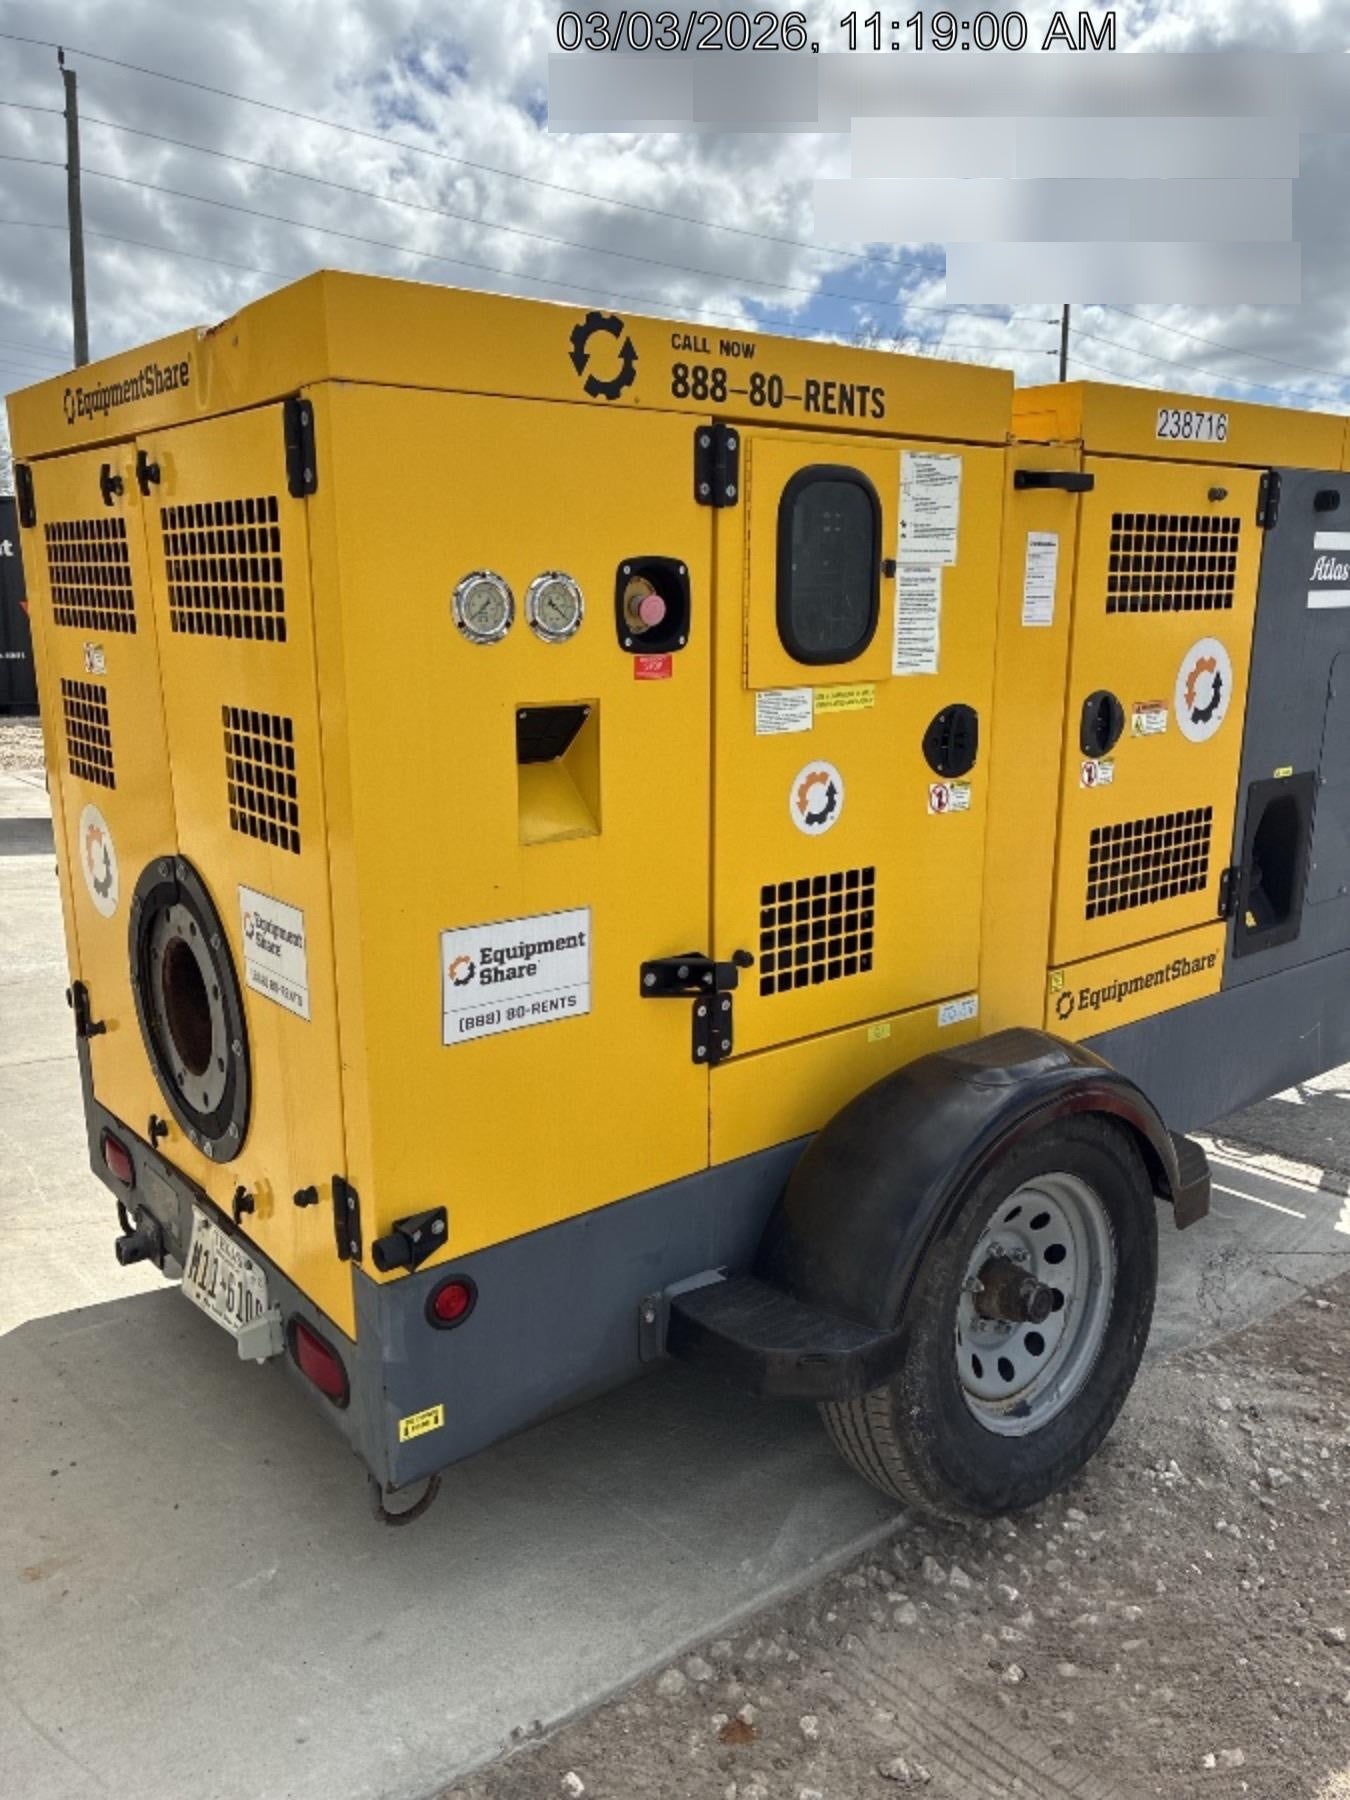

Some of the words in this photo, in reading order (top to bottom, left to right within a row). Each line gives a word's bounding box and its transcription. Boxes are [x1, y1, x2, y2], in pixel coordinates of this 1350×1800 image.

[671, 333, 711, 354] CALL
[719, 339, 756, 359] NOW
[76, 361, 189, 420] EquipmentShare
[671, 361, 886, 419] 888-80-RENTS
[1157, 409, 1227, 441] 238716
[1309, 555, 1350, 581] Atlas
[479, 931, 586, 966] Equipment
[479, 963, 537, 985] Share
[1077, 953, 1217, 1011] EquipmentShare
[459, 1010, 501, 1033] (888)
[506, 995, 577, 1021] 80-RENTS
